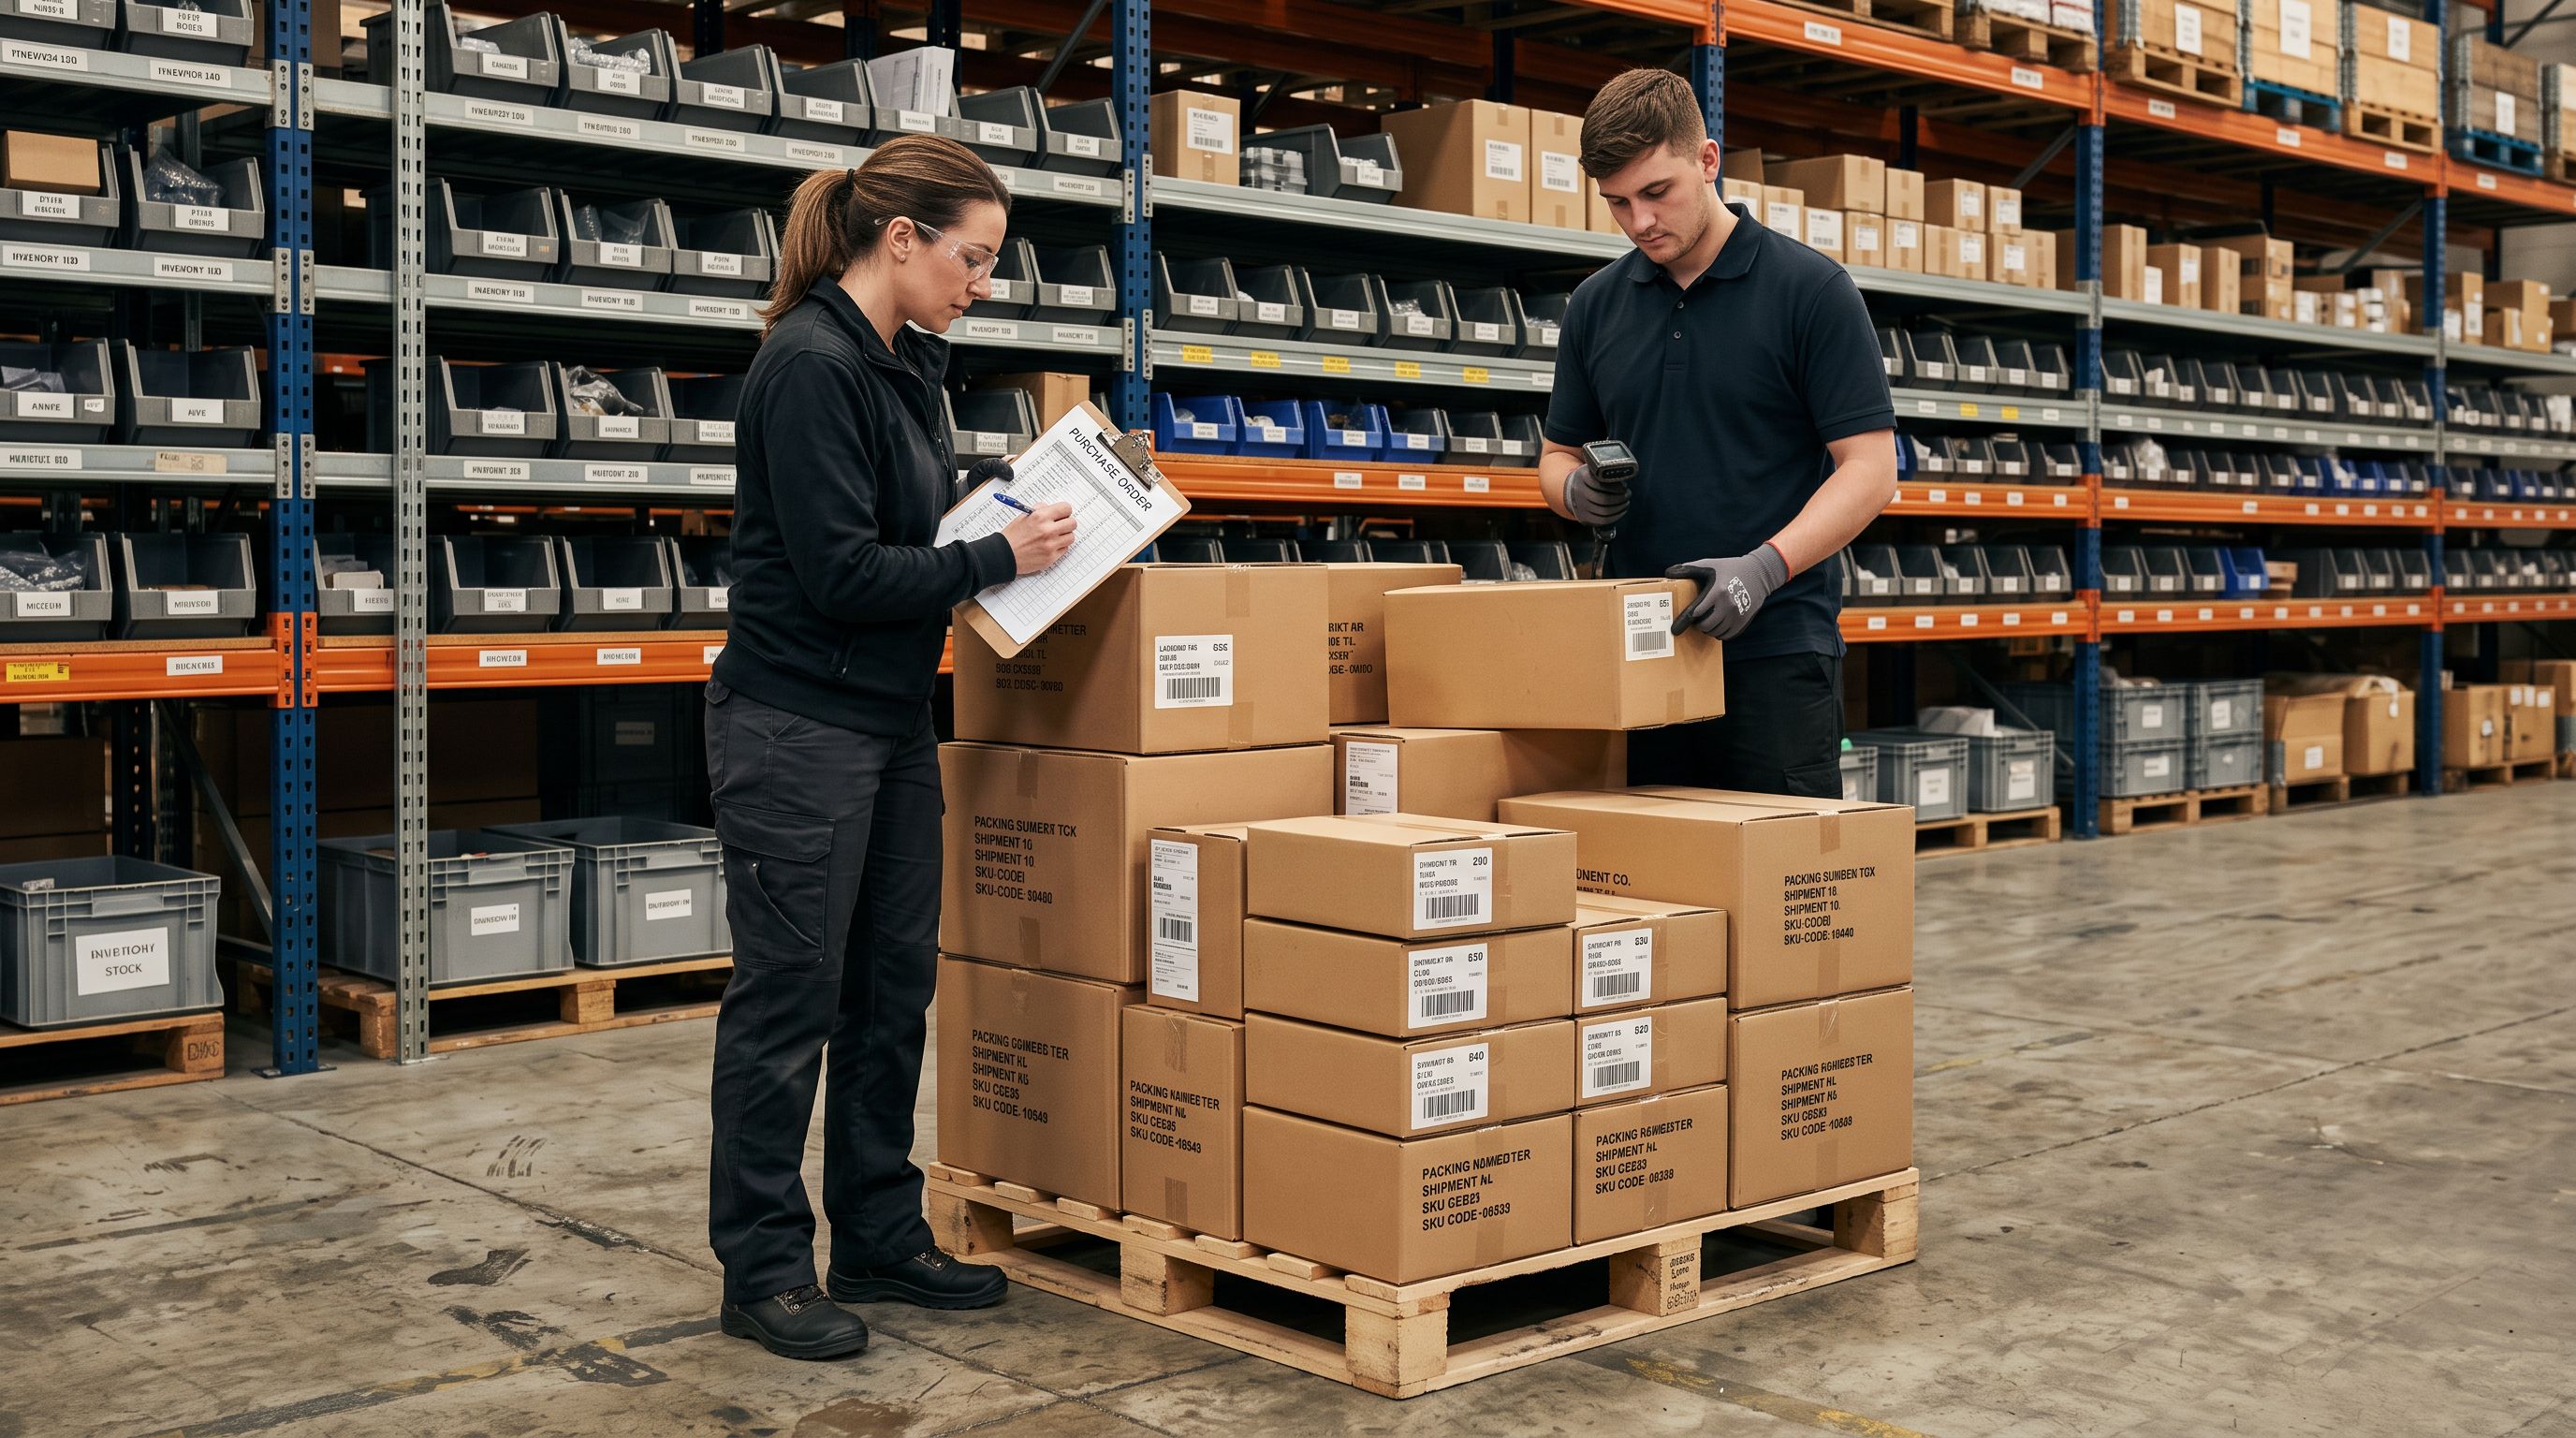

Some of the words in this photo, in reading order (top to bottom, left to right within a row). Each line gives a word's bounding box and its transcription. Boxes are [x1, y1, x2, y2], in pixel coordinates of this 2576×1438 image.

[1069, 428, 1120, 478] PURCHASE
[1118, 477, 1152, 512] ORDER
[974, 815, 1015, 831] PACKING
[1058, 824, 1077, 837] TCK
[974, 832, 1020, 848] SHIPMENT
[1022, 838, 1032, 851] 10
[974, 849, 1022, 866] SHIPMENT
[1472, 856, 1488, 866] 290
[1613, 873, 1632, 887] CO.
[1784, 872, 1822, 887] PACKING
[1784, 887, 1826, 902] SHIPMENT
[1784, 902, 1828, 917] SHIPMENT
[1468, 951, 1484, 962] 650
[105, 963, 142, 976] STOCK
[973, 1029, 1009, 1048] PACKING
[1049, 1045, 1070, 1061] TER
[1781, 1064, 1819, 1080] PACKING
[1855, 1053, 1873, 1065] TER
[973, 1078, 991, 1093] SKU
[1781, 1078, 1824, 1096] SHIPMENT
[973, 1094, 991, 1110] SKU
[1130, 1079, 1168, 1099] PACKING
[1201, 1095, 1220, 1111] TER
[1781, 1092, 1825, 1110] SHIPMENT
[1130, 1110, 1149, 1125] SKU
[1781, 1112, 1800, 1125] SKU
[1130, 1125, 1149, 1140] SKU
[1149, 1131, 1174, 1148] CODE
[1596, 1128, 1638, 1147] PACKING
[1780, 1126, 1799, 1140] SKU
[1596, 1143, 1645, 1163] SHIPMENT
[1422, 1160, 1471, 1181] PACKING
[1510, 1149, 1531, 1163] TER
[1595, 1164, 1616, 1179] SKU
[1422, 1175, 1478, 1197] SHIPMENT
[1595, 1181, 1616, 1195] SKU
[1617, 1174, 1646, 1190] CODE
[1422, 1199, 1445, 1214] SKU
[1422, 1216, 1445, 1231] SKU
[1447, 1209, 1478, 1225] CODE
